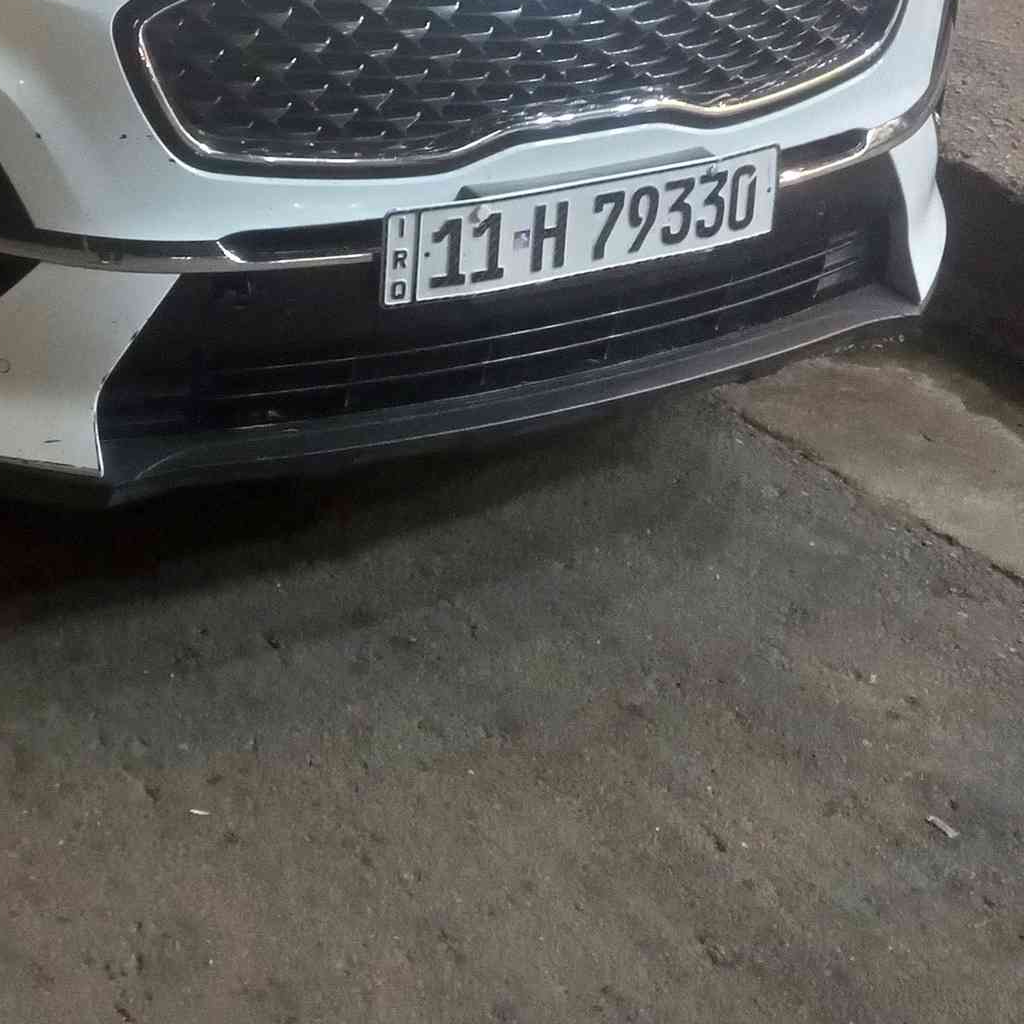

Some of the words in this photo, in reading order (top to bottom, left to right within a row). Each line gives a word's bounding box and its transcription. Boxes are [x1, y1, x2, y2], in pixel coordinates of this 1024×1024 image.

[429, 211, 504, 288] 11
[530, 201, 569, 273] H
[592, 163, 757, 261] 79330
